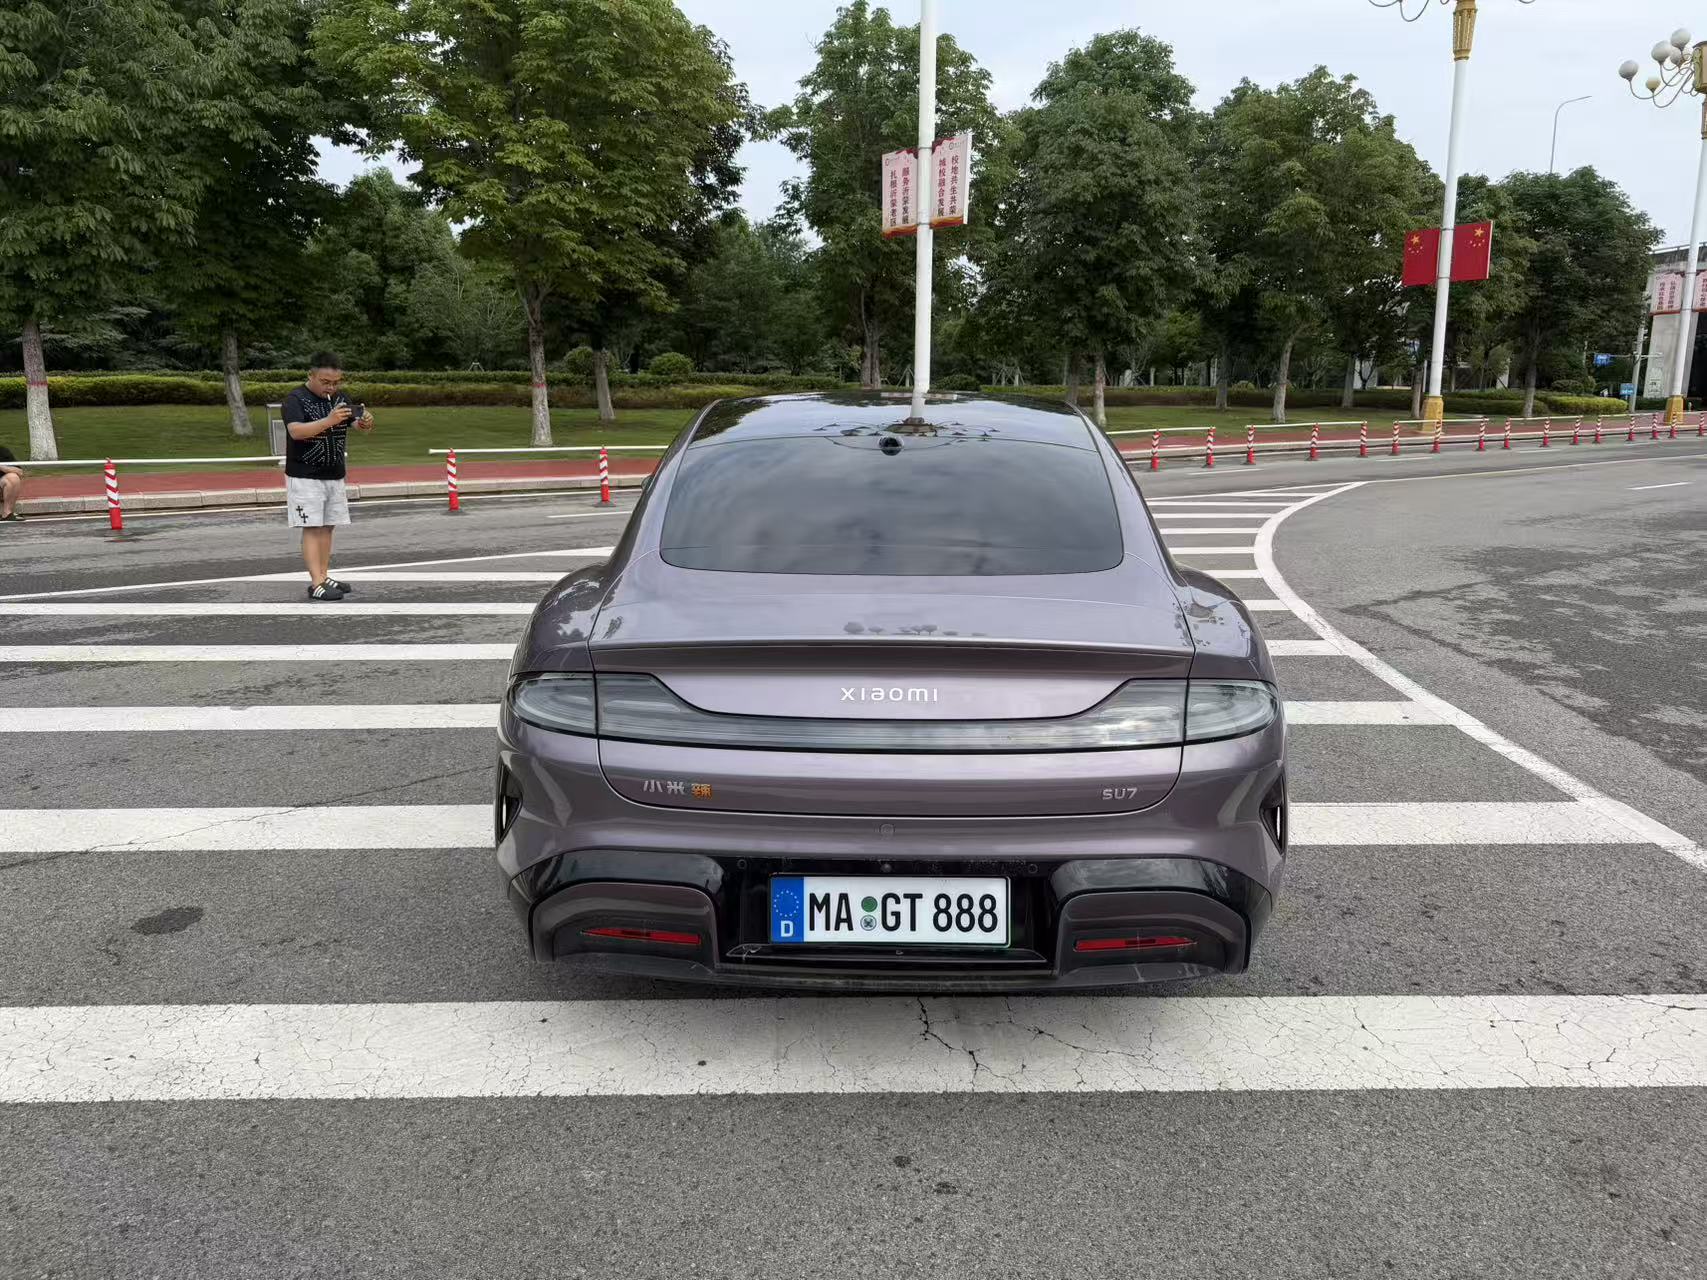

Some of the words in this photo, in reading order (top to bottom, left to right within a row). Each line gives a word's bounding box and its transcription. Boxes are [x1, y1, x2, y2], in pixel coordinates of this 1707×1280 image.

[901, 167, 910, 224] 服务沂蒙发展
[948, 155, 959, 215] 校地共生共荣
[1102, 787, 1138, 800] SU7
[780, 920, 794, 938] D
[808, 892, 854, 932] MA
[881, 892, 924, 932] GT
[932, 893, 998, 933] 888
